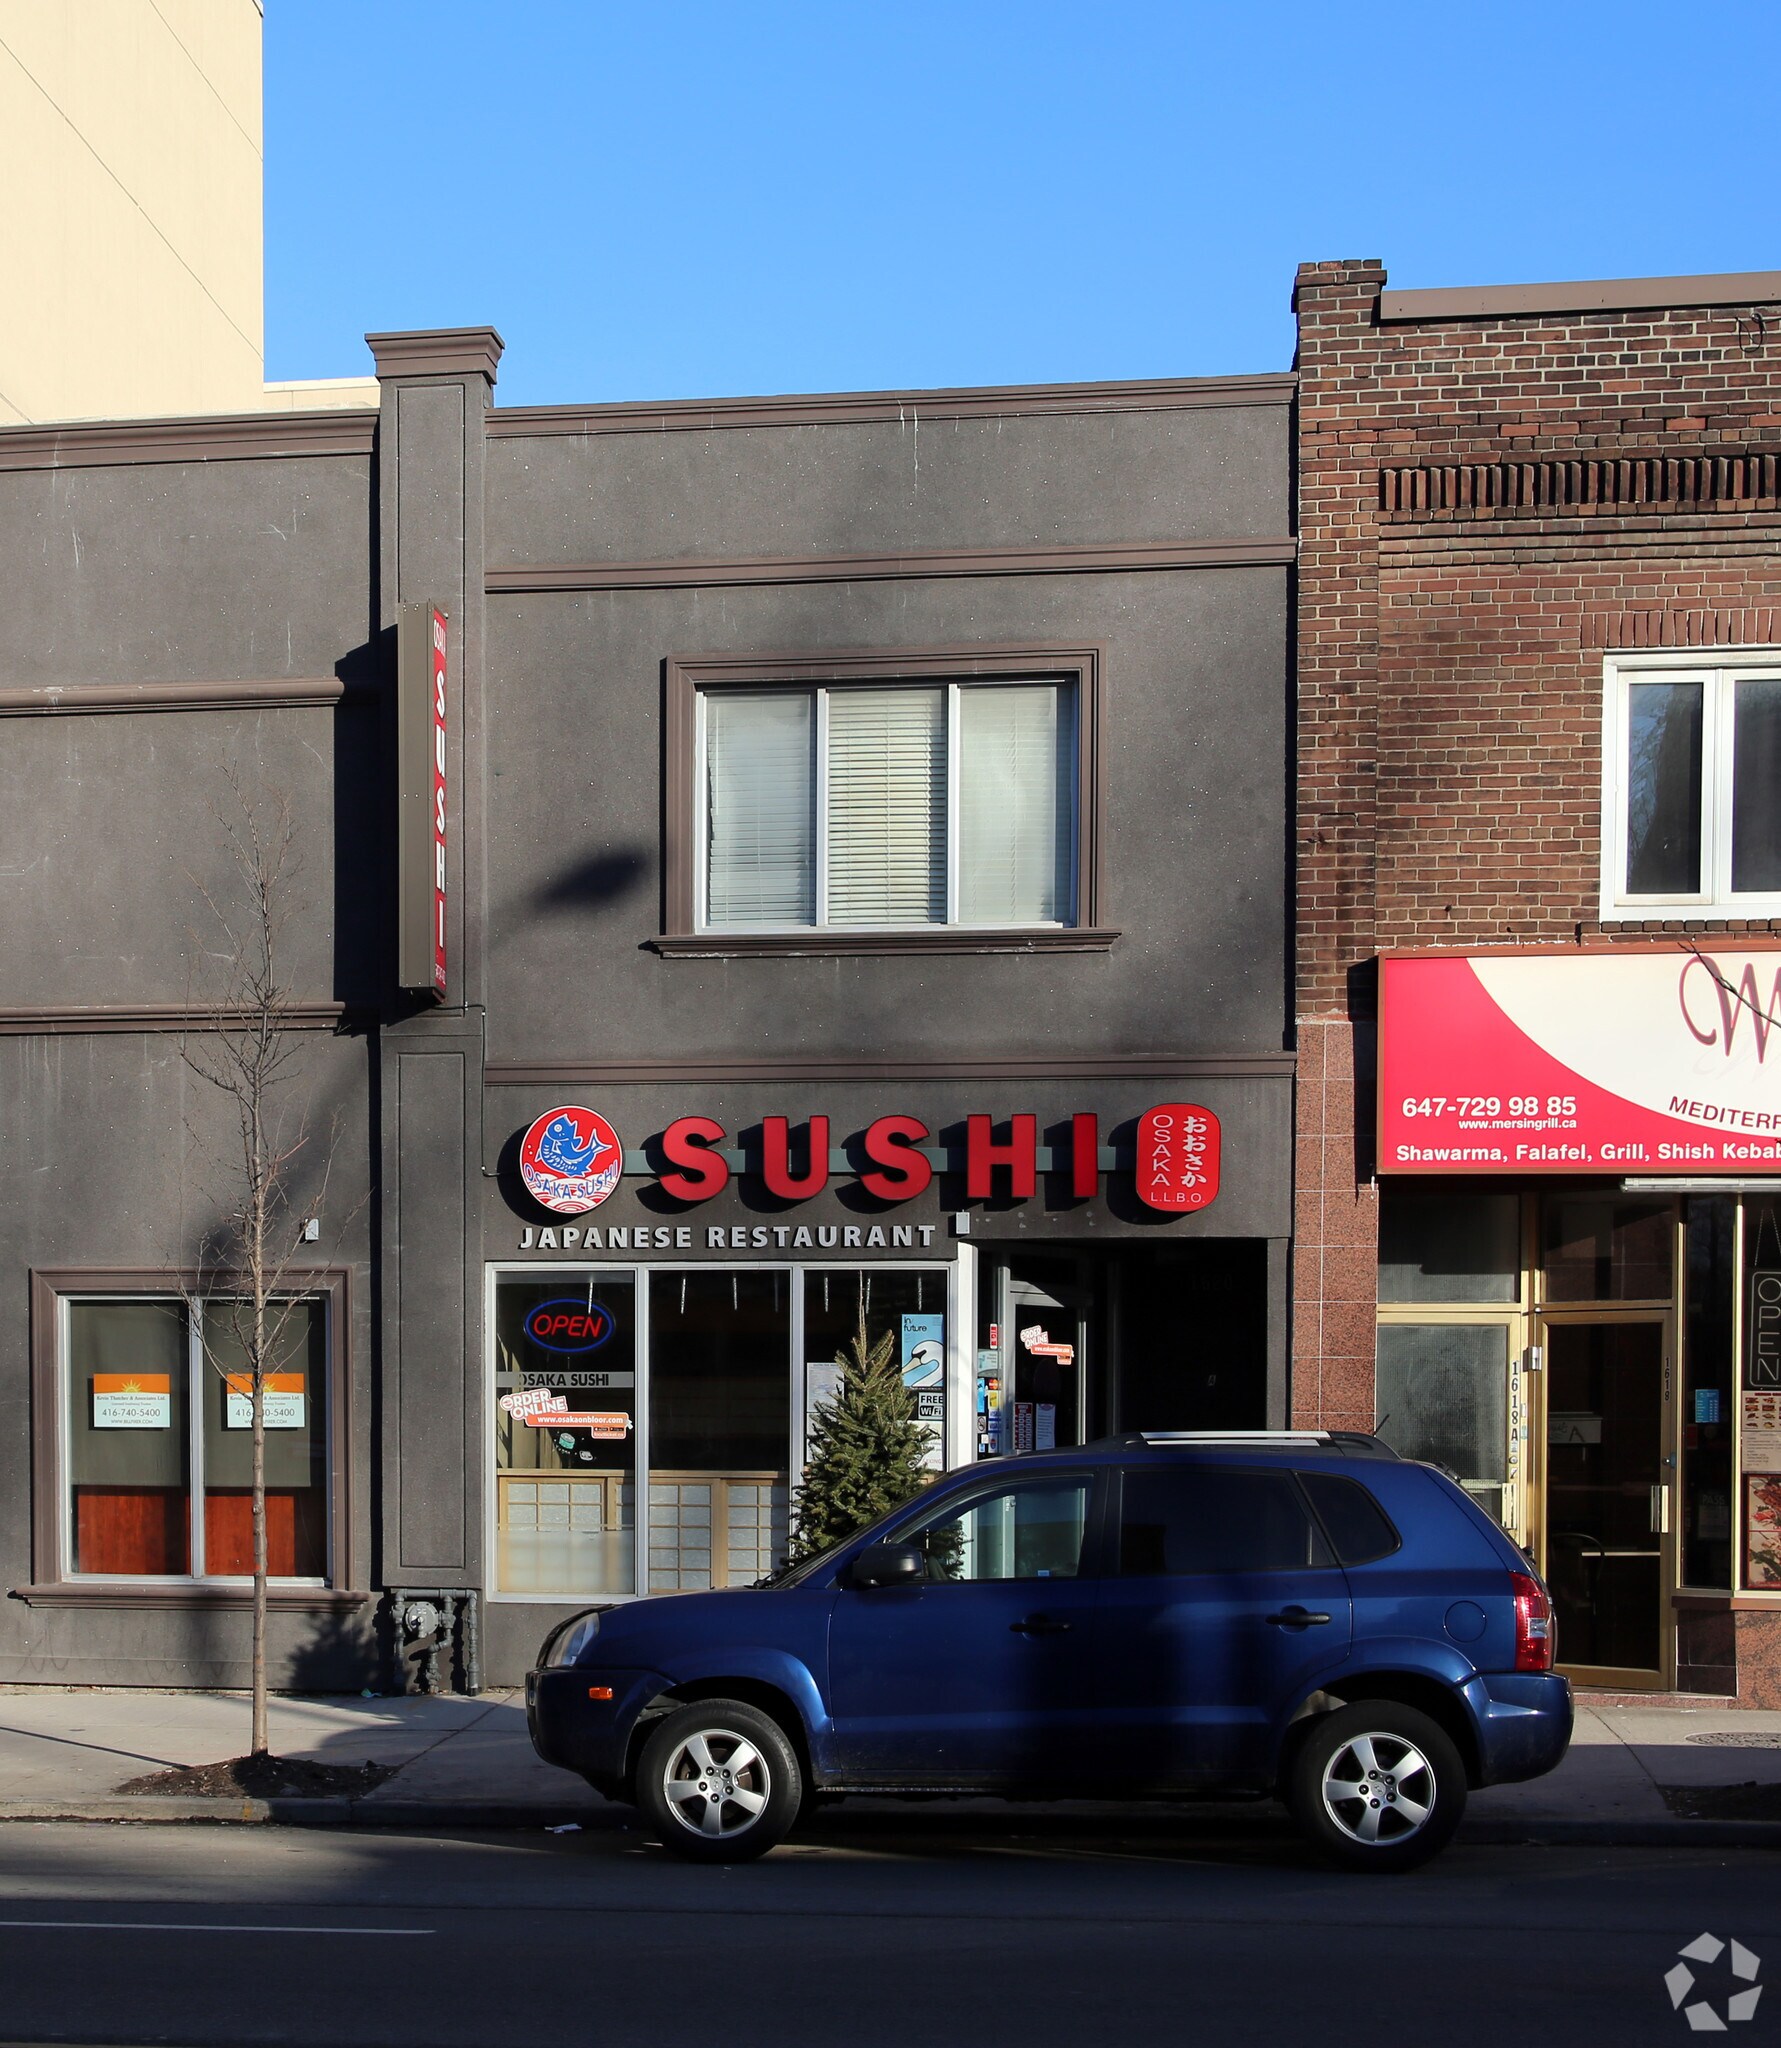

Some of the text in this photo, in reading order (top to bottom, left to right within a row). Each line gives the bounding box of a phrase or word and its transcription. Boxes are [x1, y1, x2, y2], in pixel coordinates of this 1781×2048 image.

[435, 669, 446, 949] SUSHI
[1402, 1096, 1577, 1117] 647-729 98 85
[1458, 1117, 1577, 1131] www.mersingrill.ca
[658, 1113, 1098, 1201] SUSHI
[1151, 1114, 1174, 1187] OSAKA
[1180, 1115, 1207, 1188] おおさか
[1396, 1145, 1508, 1162] Shawarma,
[1515, 1144, 1593, 1162] Falafel,
[1600, 1143, 1650, 1162] Grill,
[1657, 1143, 1715, 1159] Shish
[524, 1158, 618, 1199] OSAKA SUSHI
[1150, 1192, 1205, 1203] L.L.B.O.
[519, 1224, 936, 1249] JAPANESE RESTAURANT
[533, 1314, 603, 1338] OPEN
[903, 1324, 928, 1332] future
[1757, 1277, 1781, 1381] OPEN
[570, 1373, 609, 1386] SUSHI
[501, 1390, 550, 1409] ORDER
[512, 1399, 566, 1418] ONLINE
[920, 1395, 943, 1403] FREE
[102, 1408, 161, 1417] 416-740-5400
[236, 1408, 295, 1417] 416-0-5400
[537, 1415, 624, 1424] www.osakaonbloor.com
